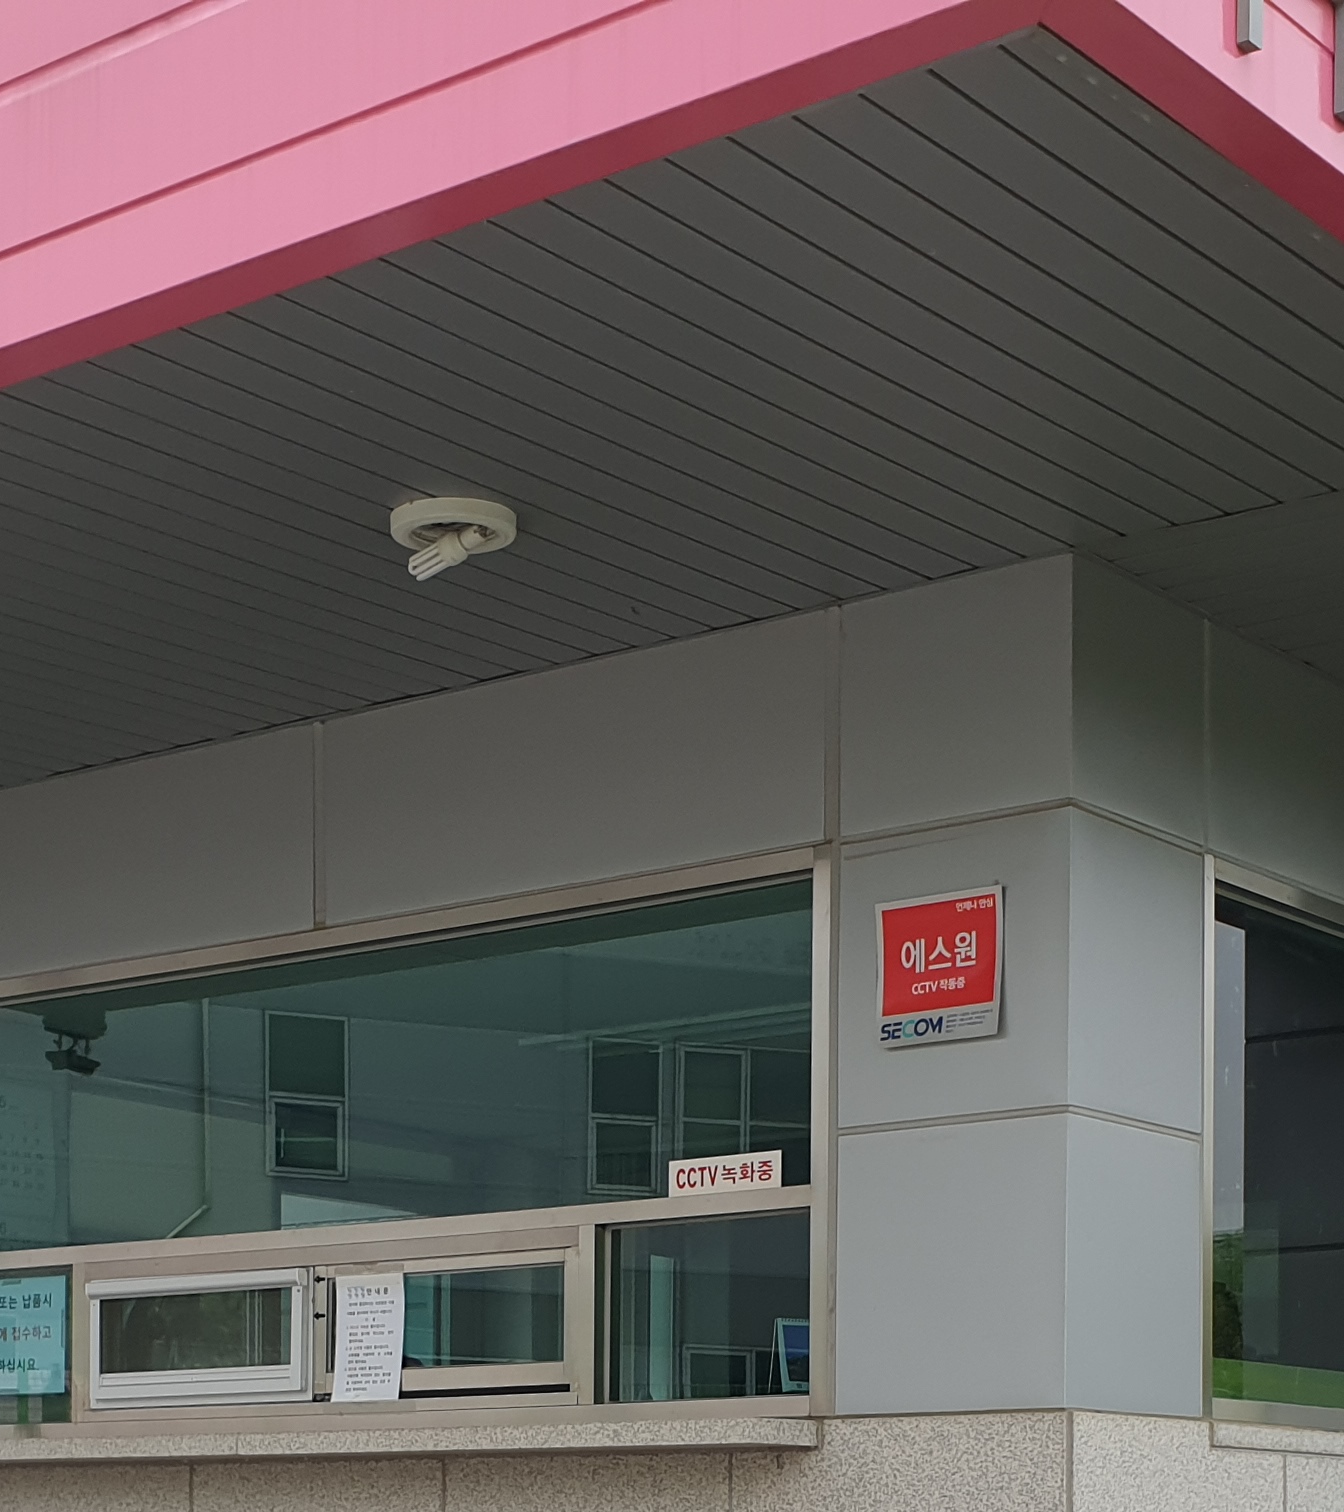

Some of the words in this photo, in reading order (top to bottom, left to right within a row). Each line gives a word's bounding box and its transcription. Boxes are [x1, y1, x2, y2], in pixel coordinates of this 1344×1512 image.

[901, 930, 976, 973] 에스원
[912, 982, 937, 994] CCTV
[880, 1016, 943, 1041] SECOM
[676, 1165, 718, 1189] CCTV
[721, 1160, 773, 1184] 녹화중
[22, 1292, 52, 1310] 납품시
[12, 1325, 51, 1341] 접수하고
